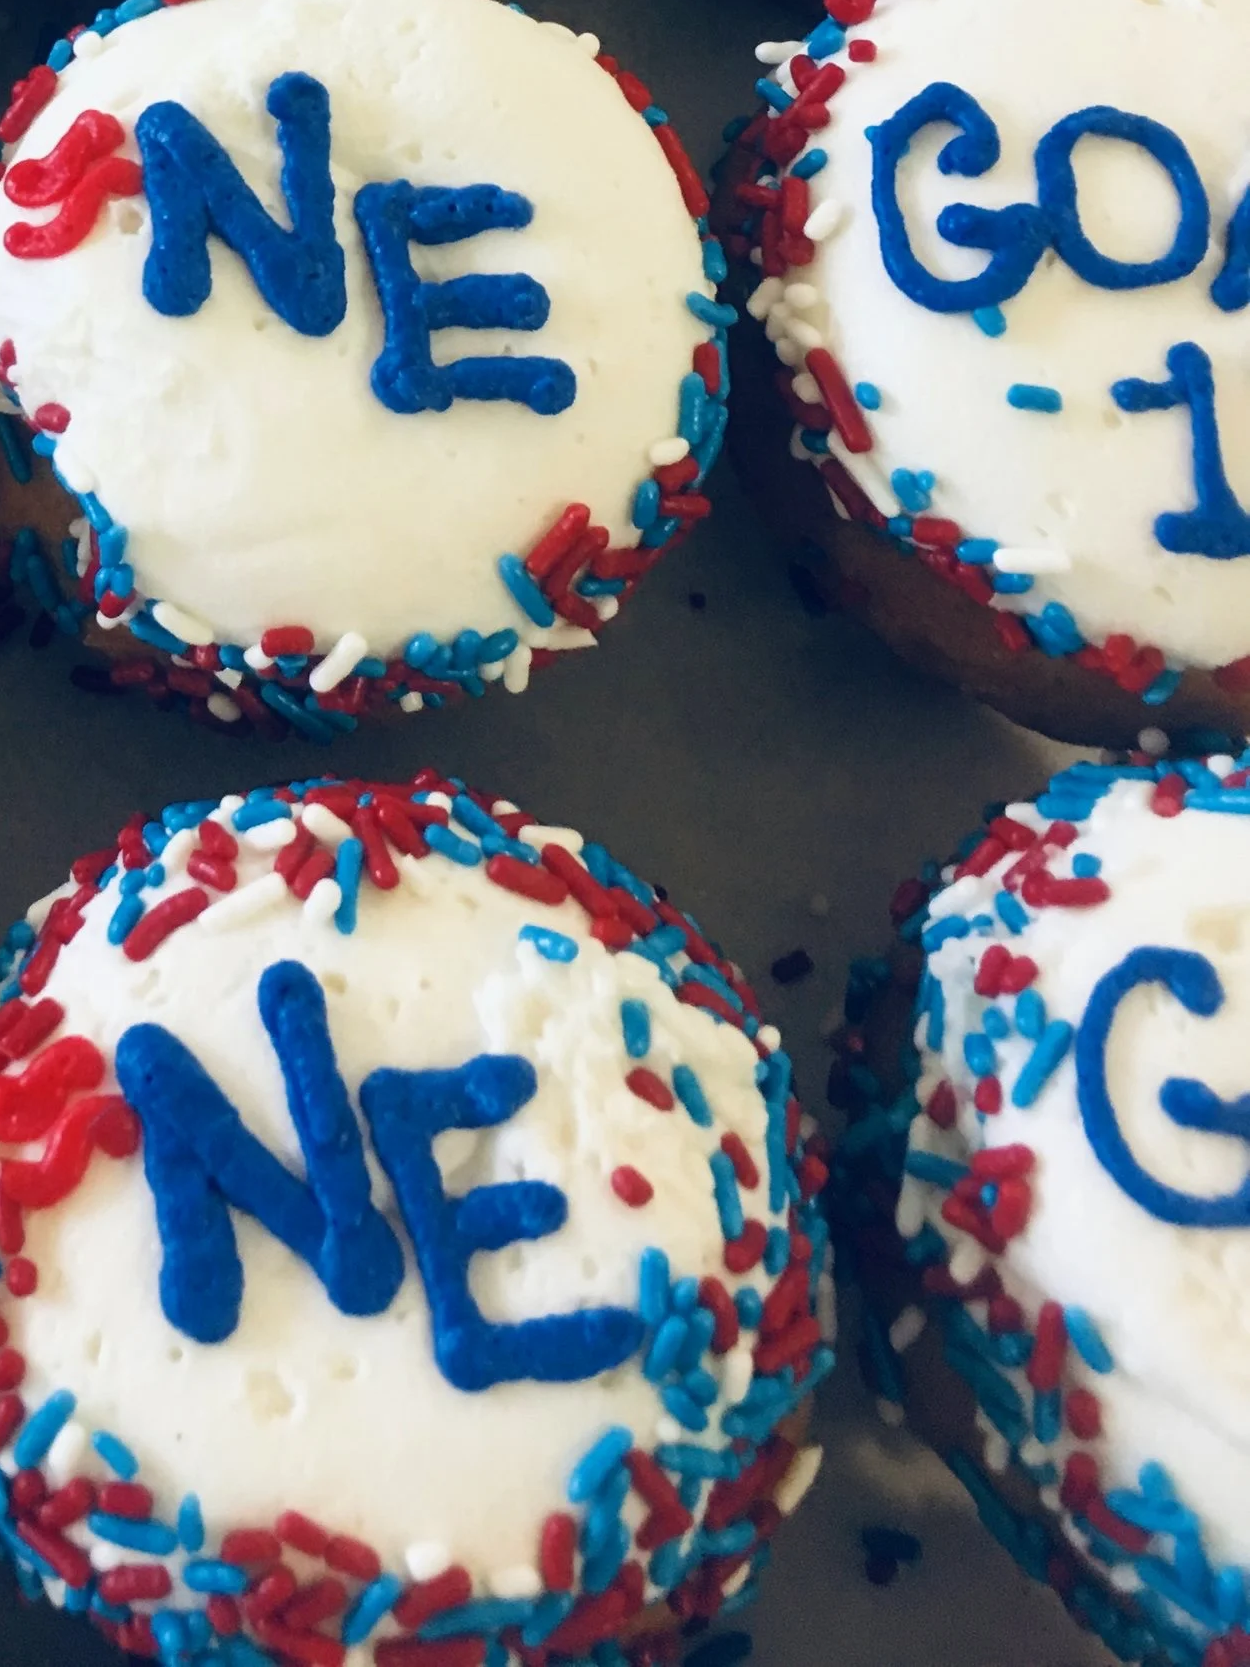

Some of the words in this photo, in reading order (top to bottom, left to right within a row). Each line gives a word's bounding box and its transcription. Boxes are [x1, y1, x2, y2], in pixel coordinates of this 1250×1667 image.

[135, 71, 577, 415] NE
[865, 82, 1250, 313] GO
[115, 961, 643, 1391] NE
